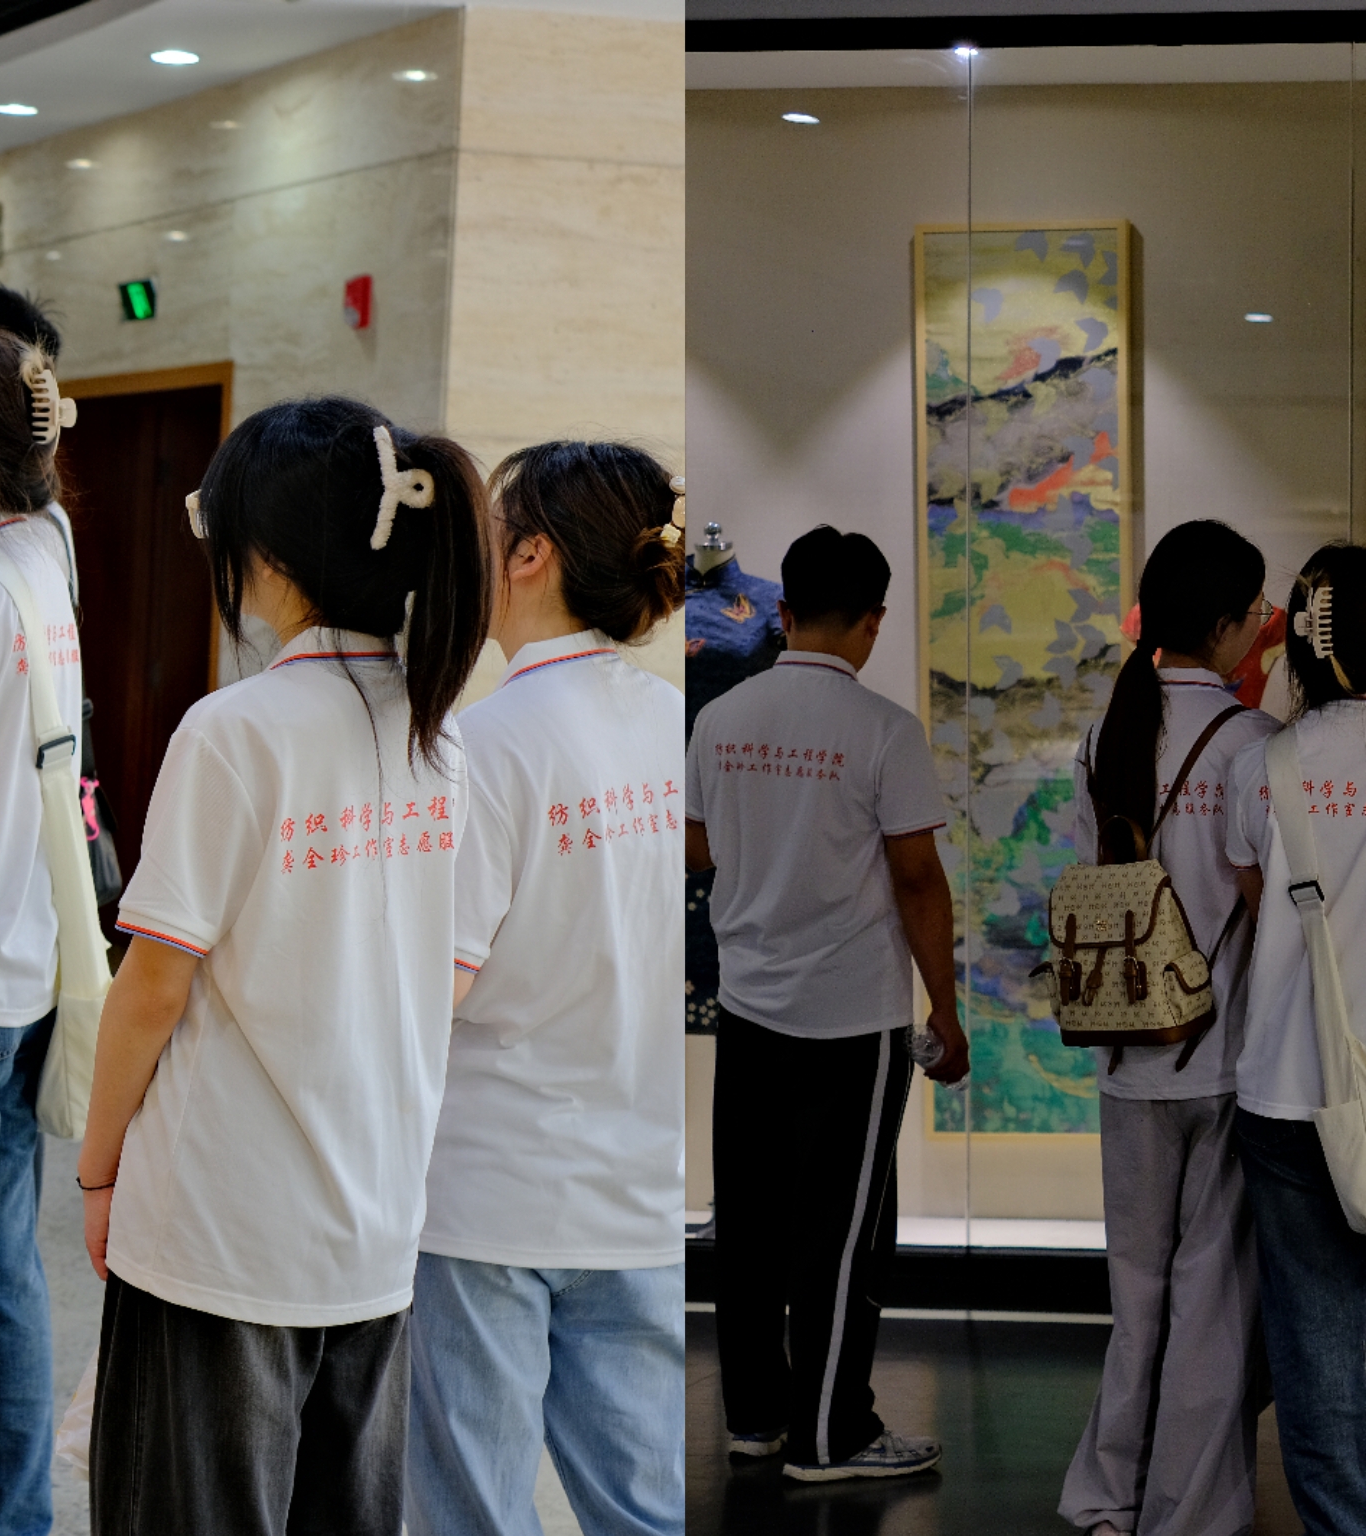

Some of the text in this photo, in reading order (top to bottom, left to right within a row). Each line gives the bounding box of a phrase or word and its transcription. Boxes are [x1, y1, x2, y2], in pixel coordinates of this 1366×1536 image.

[547, 779, 679, 826] 纺织科学与工
